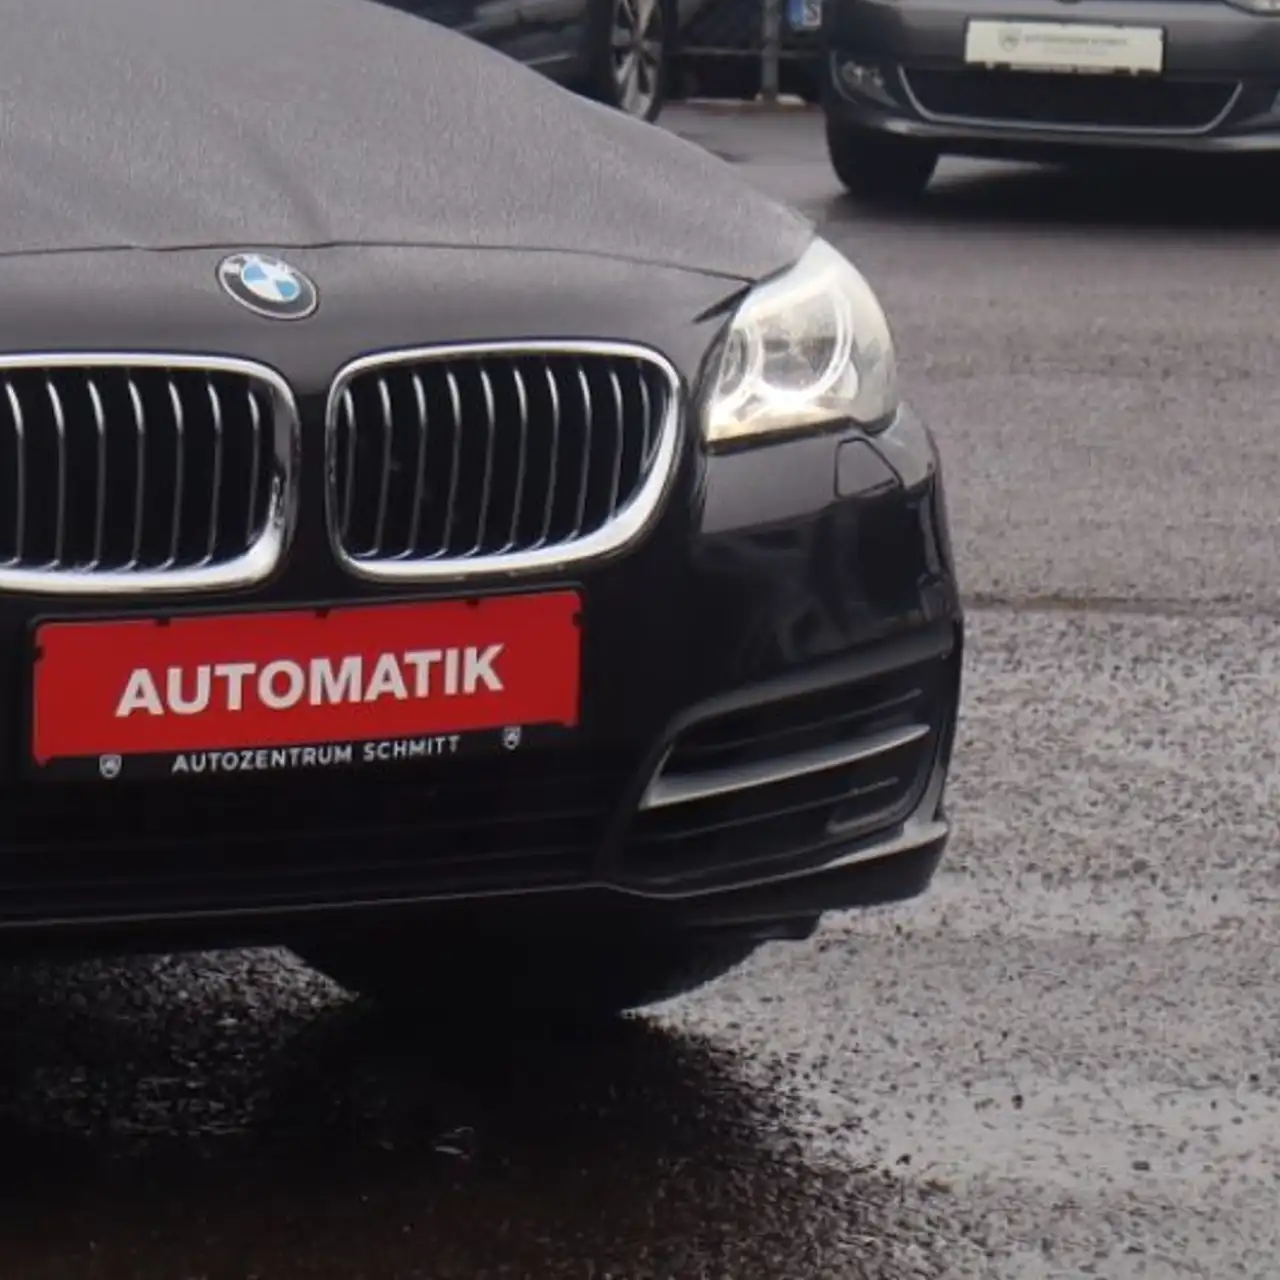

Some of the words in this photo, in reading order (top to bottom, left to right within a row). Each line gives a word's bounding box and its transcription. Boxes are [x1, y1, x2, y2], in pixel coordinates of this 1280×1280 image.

[114, 643, 505, 718] AUTOMATIK
[171, 743, 353, 774] AUTOZENTRUM
[362, 734, 461, 763] SCHMITT
